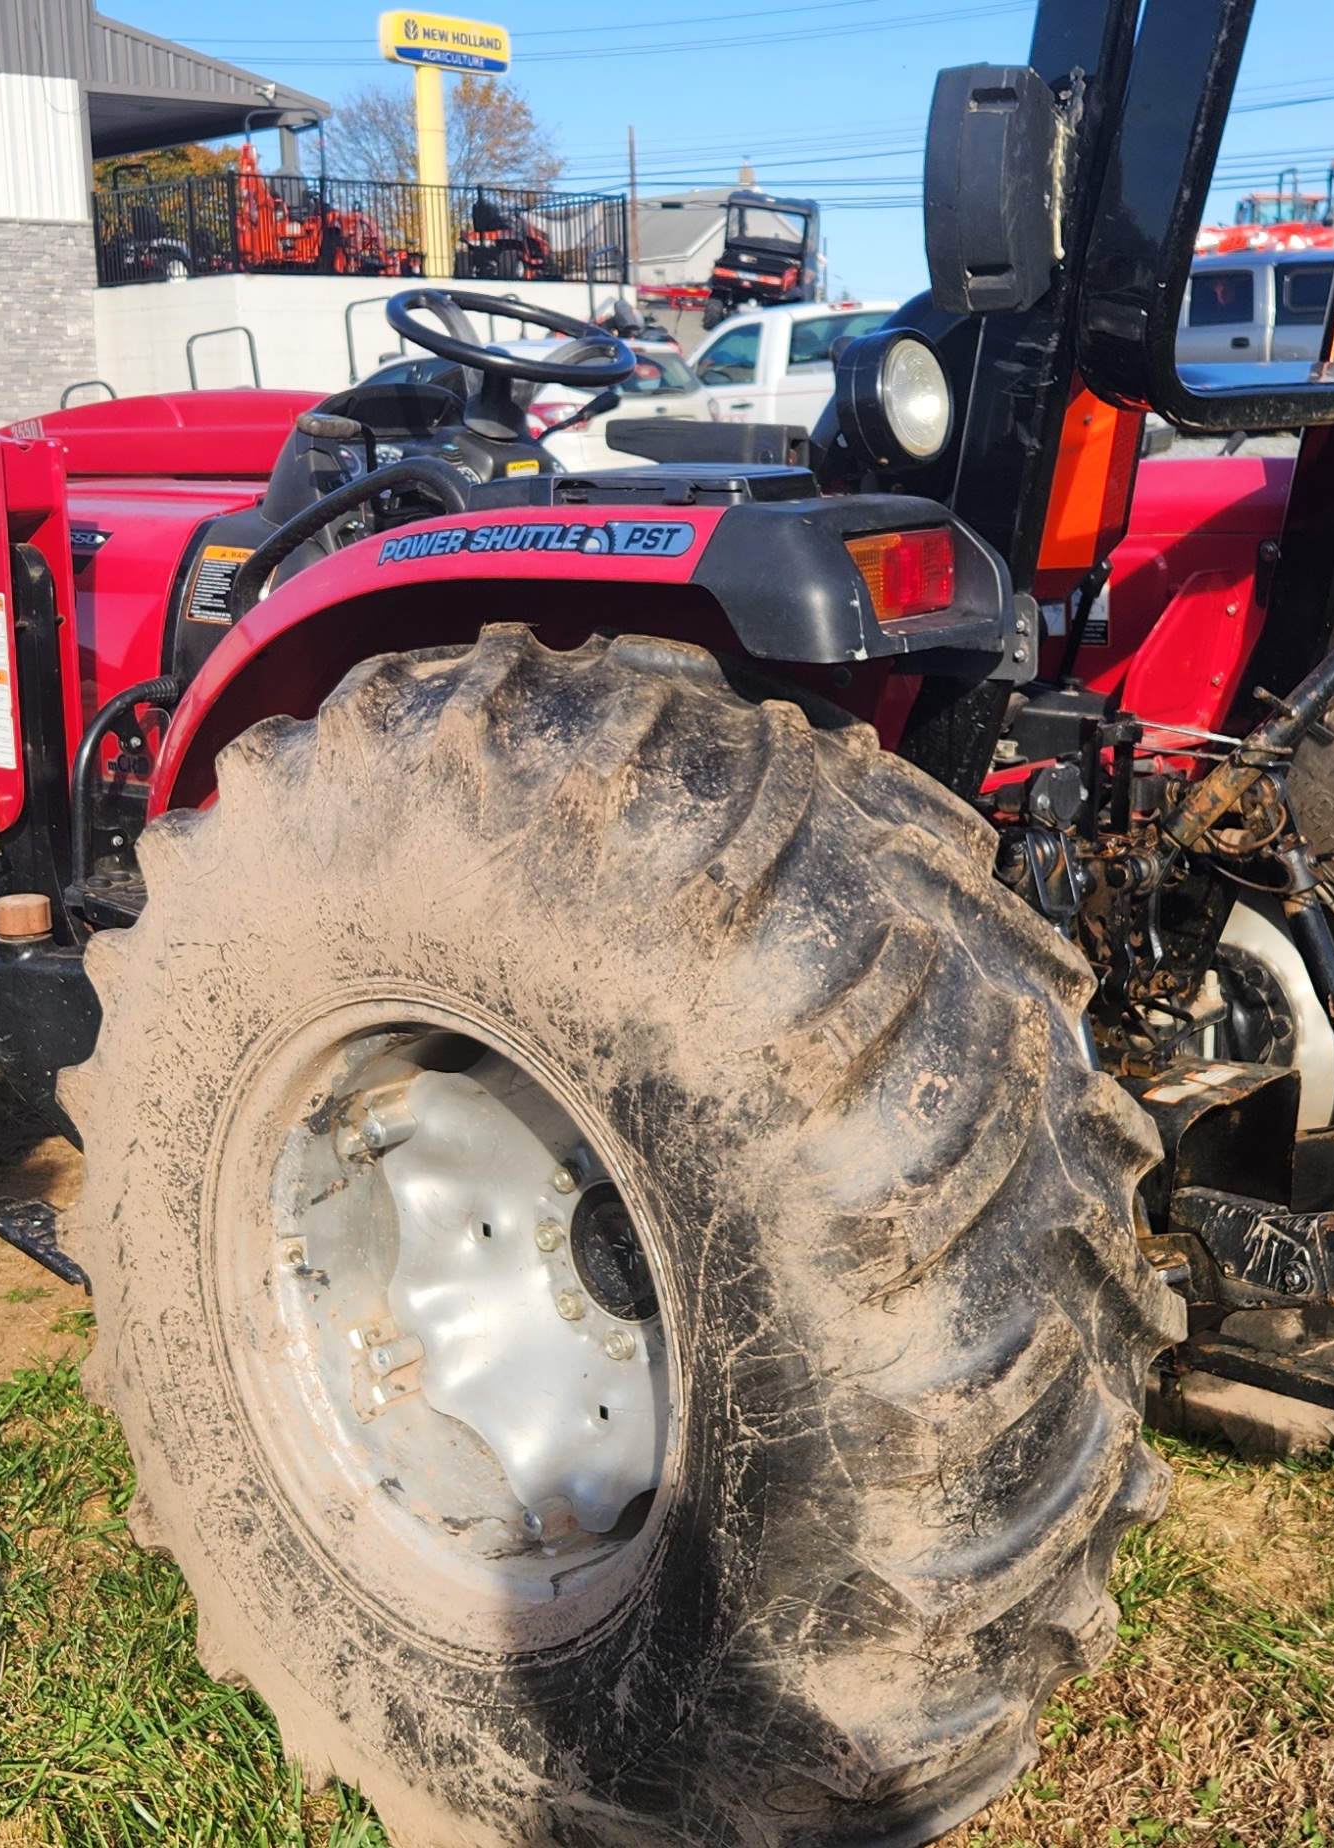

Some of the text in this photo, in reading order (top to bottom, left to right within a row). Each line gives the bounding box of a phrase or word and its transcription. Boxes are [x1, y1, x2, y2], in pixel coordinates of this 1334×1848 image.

[422, 27, 502, 51] NEW HOLLAND
[422, 49, 485, 68] AGRICULTURE
[378, 524, 682, 567] POWER SHUTTLE PST
